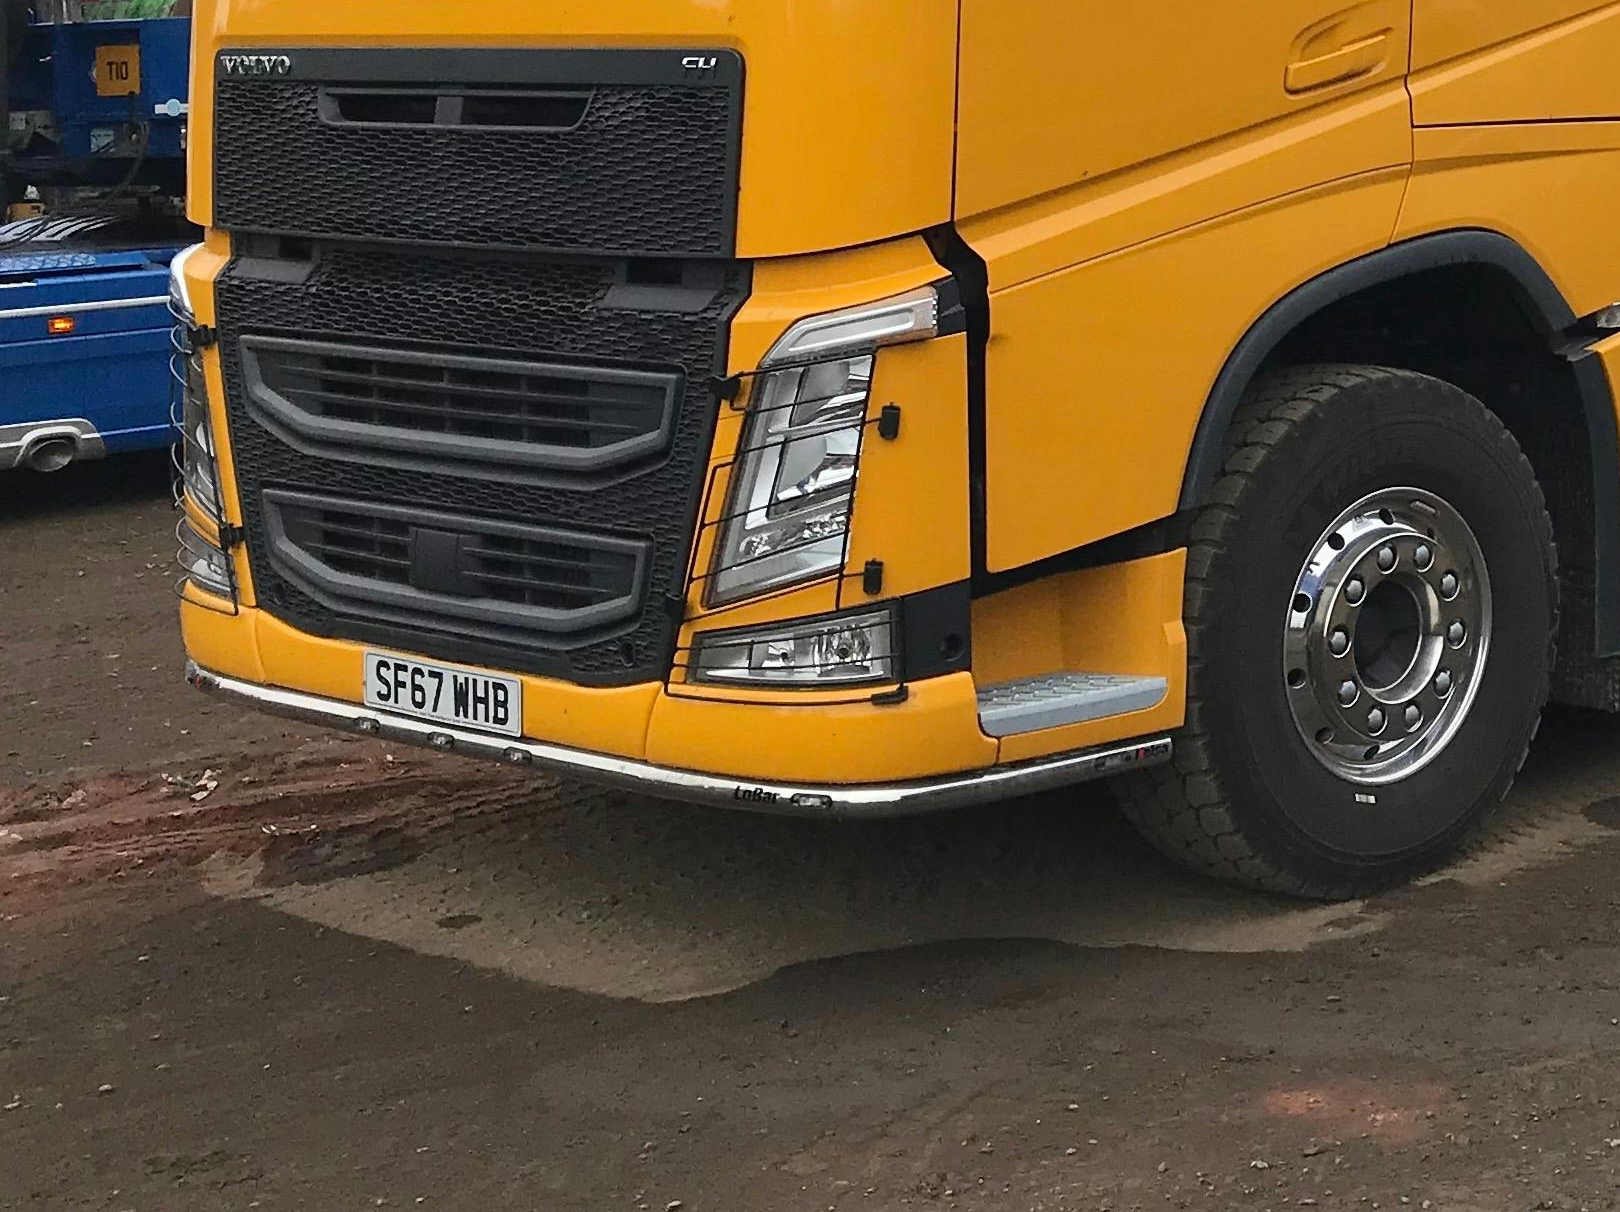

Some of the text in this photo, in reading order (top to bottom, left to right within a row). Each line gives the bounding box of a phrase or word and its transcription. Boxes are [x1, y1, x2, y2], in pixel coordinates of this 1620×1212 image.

[220, 55, 291, 76] VOLVO
[376, 659, 510, 726] SF67 WHB
